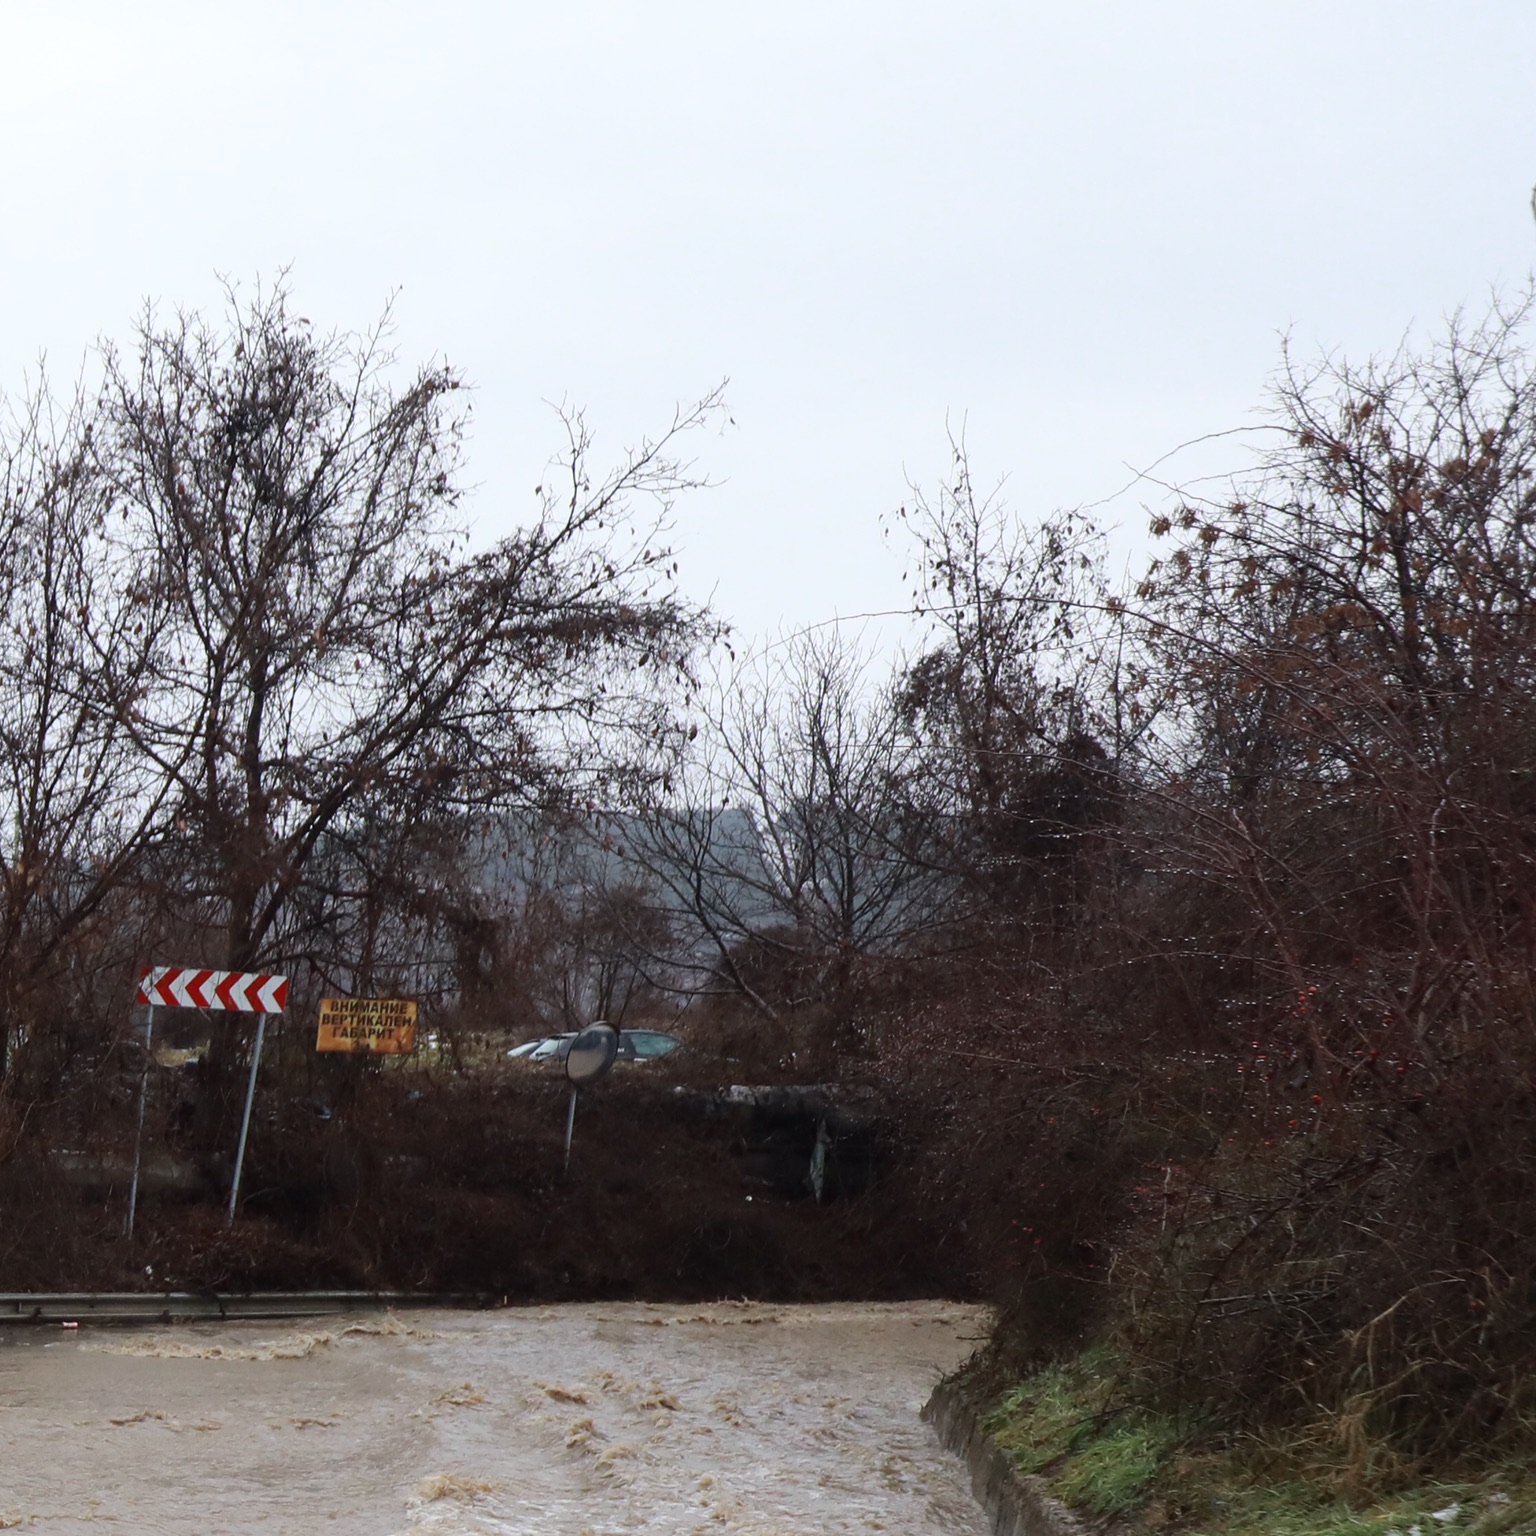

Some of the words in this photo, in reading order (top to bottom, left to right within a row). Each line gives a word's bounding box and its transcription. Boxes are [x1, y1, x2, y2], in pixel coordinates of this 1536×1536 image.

[331, 1001, 408, 1014] ВНИМАНИЕ
[322, 1013, 412, 1027] ВЕРТИКАЛЕН
[333, 1027, 395, 1039] ГАБАРИТ
